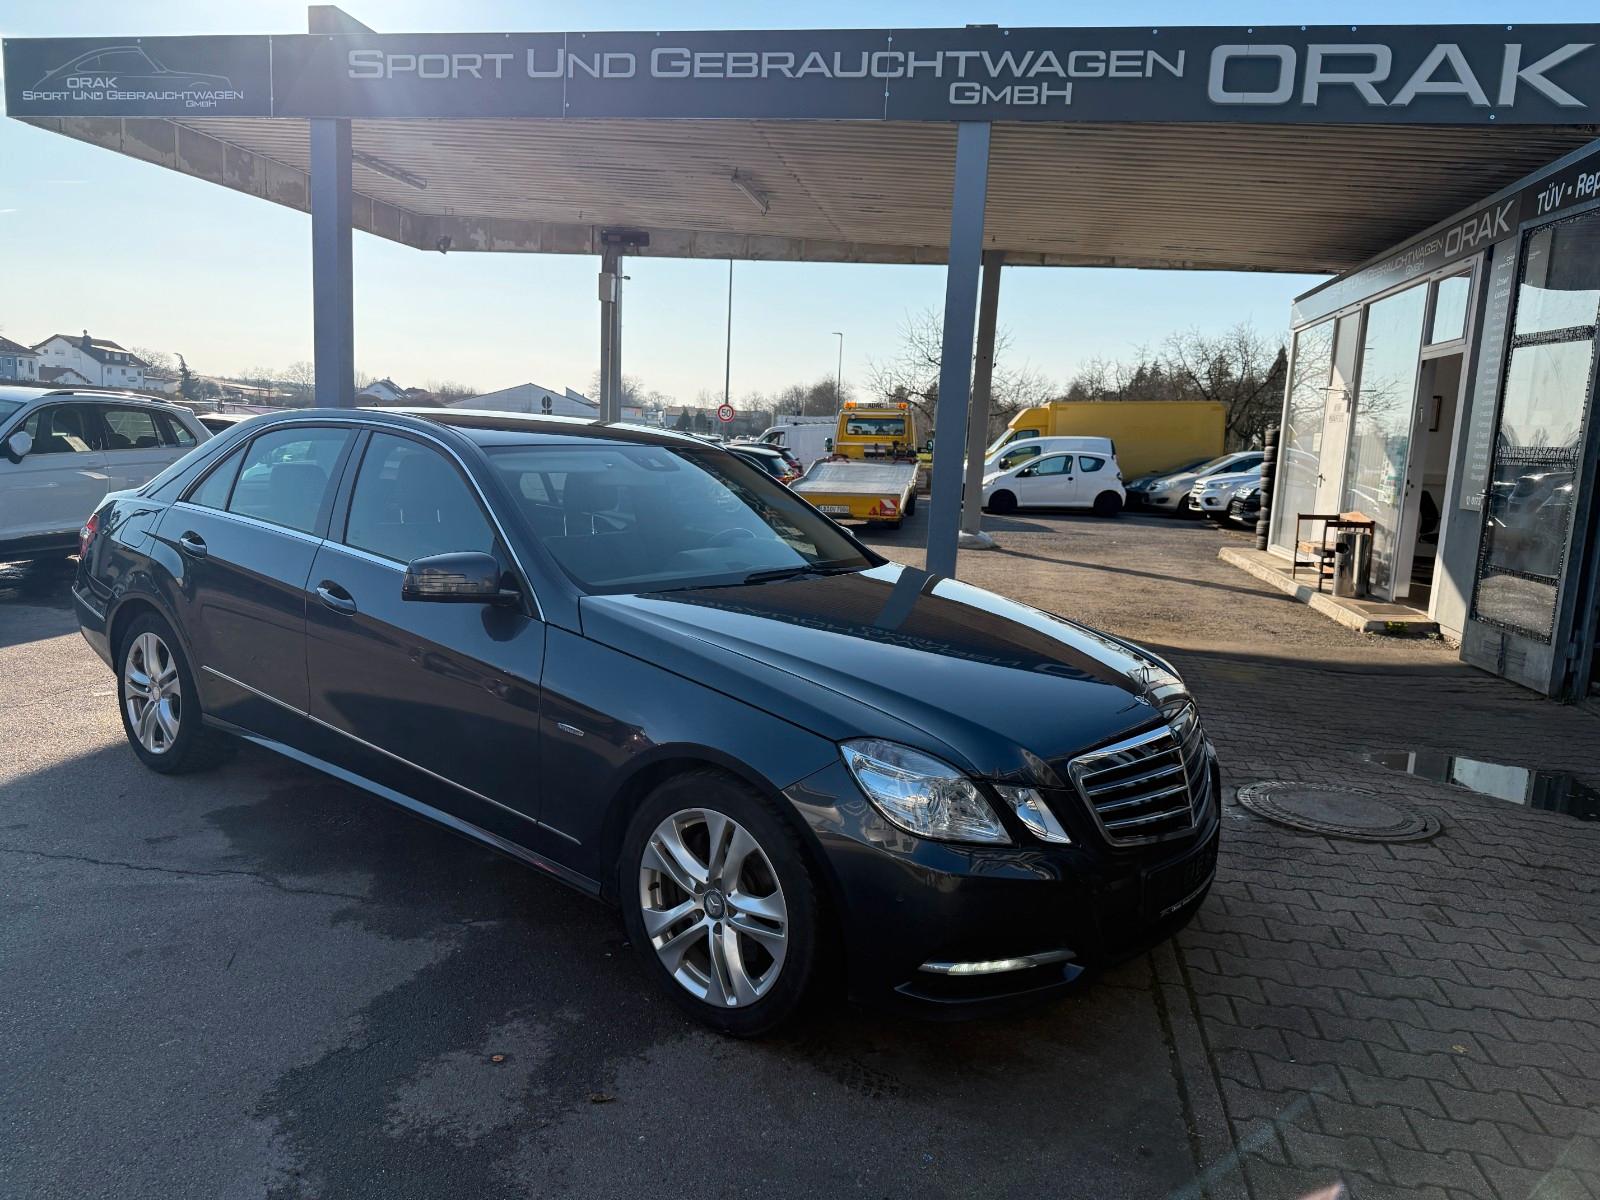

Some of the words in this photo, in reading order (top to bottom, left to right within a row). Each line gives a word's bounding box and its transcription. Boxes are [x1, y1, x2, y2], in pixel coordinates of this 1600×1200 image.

[348, 48, 514, 79] SPORT
[528, 48, 636, 79] UND
[650, 47, 1186, 79] GEBRAUCHTWAGEN
[1207, 43, 1597, 108] ORAK
[22, 90, 69, 101] SPORT
[72, 90, 104, 100] UND
[106, 90, 244, 101] GEBRAUCHTWAGEN
[66, 77, 118, 89] ORAK
[1537, 181, 1566, 216] TÜV
[1444, 199, 1515, 258] ORAK
[721, 408, 731, 418] 50
